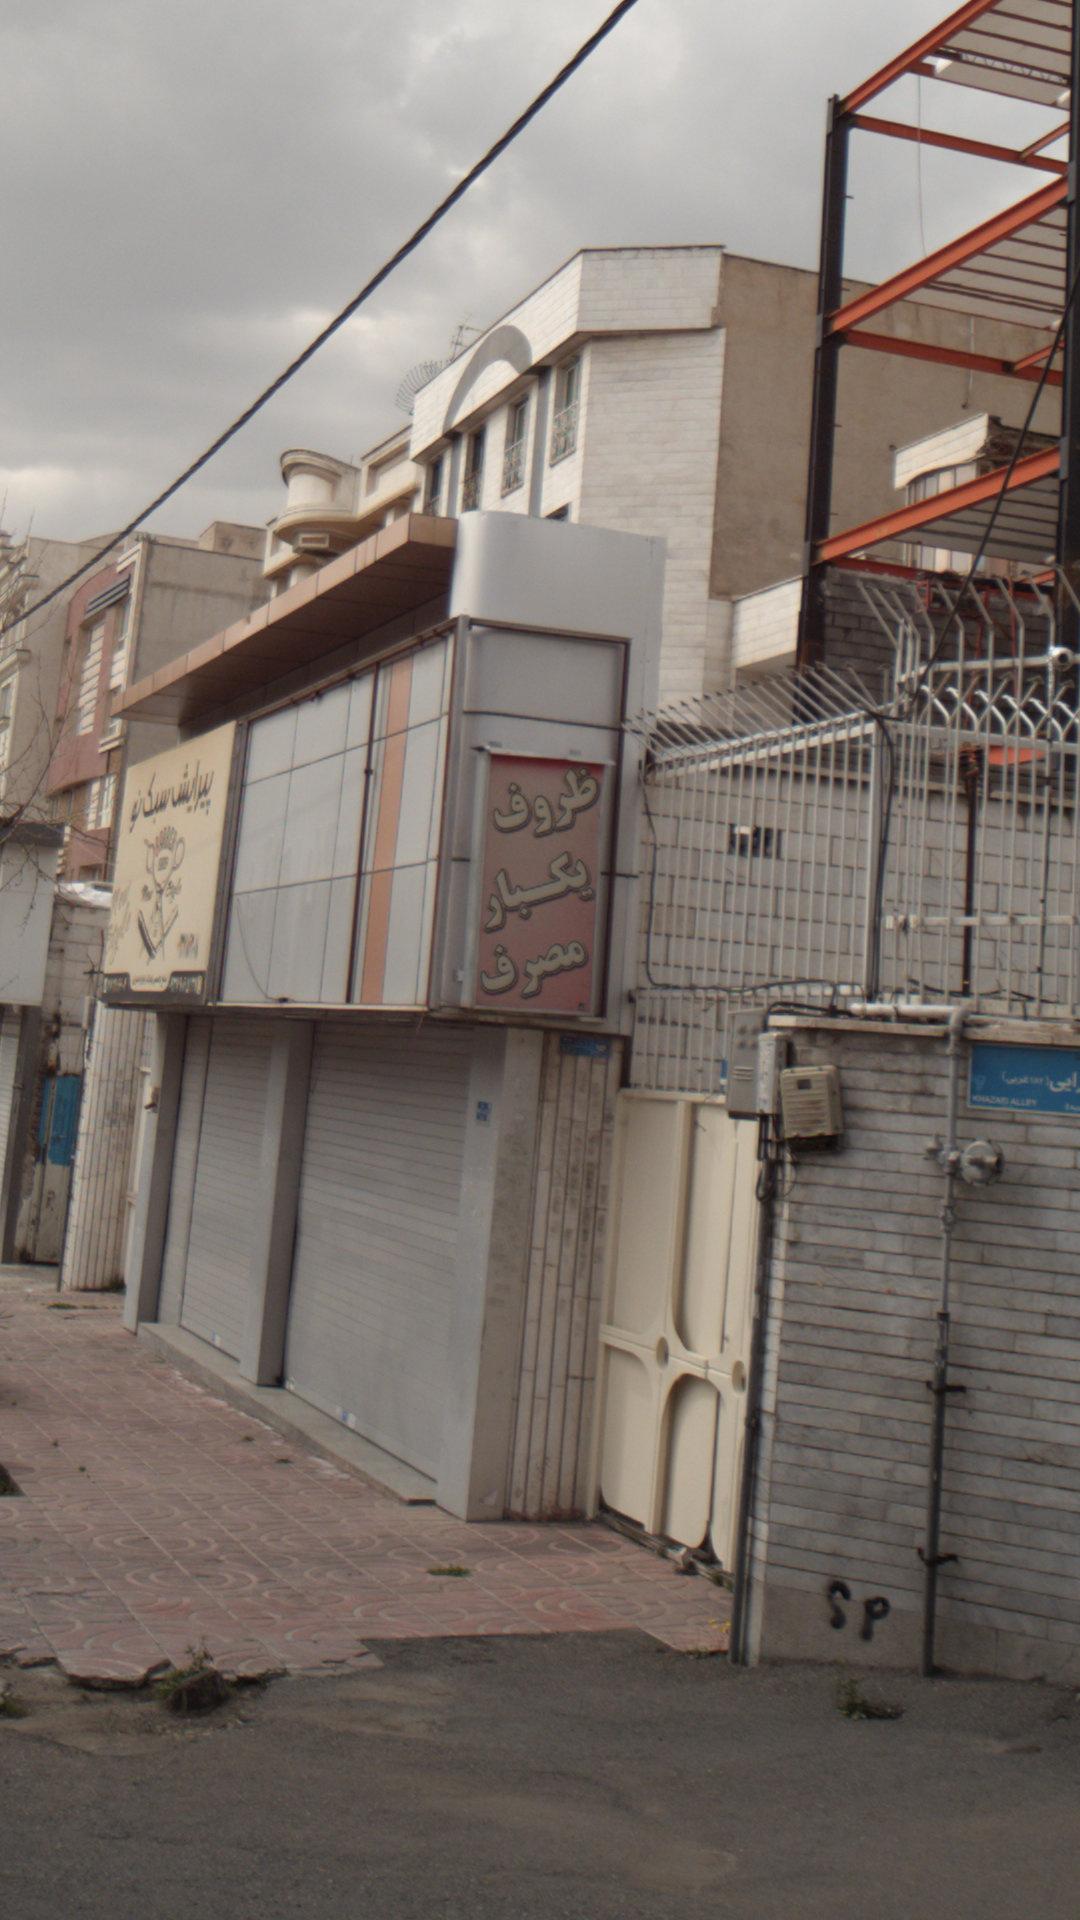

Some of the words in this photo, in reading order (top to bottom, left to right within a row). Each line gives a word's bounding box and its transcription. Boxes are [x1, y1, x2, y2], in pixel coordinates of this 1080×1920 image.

[129, 789, 144, 834] نو
[143, 771, 171, 825] سبک
[172, 759, 215, 816] پیرایش
[494, 767, 601, 837] ظروف
[484, 851, 594, 933] یکبار
[479, 942, 589, 998] مصرف
